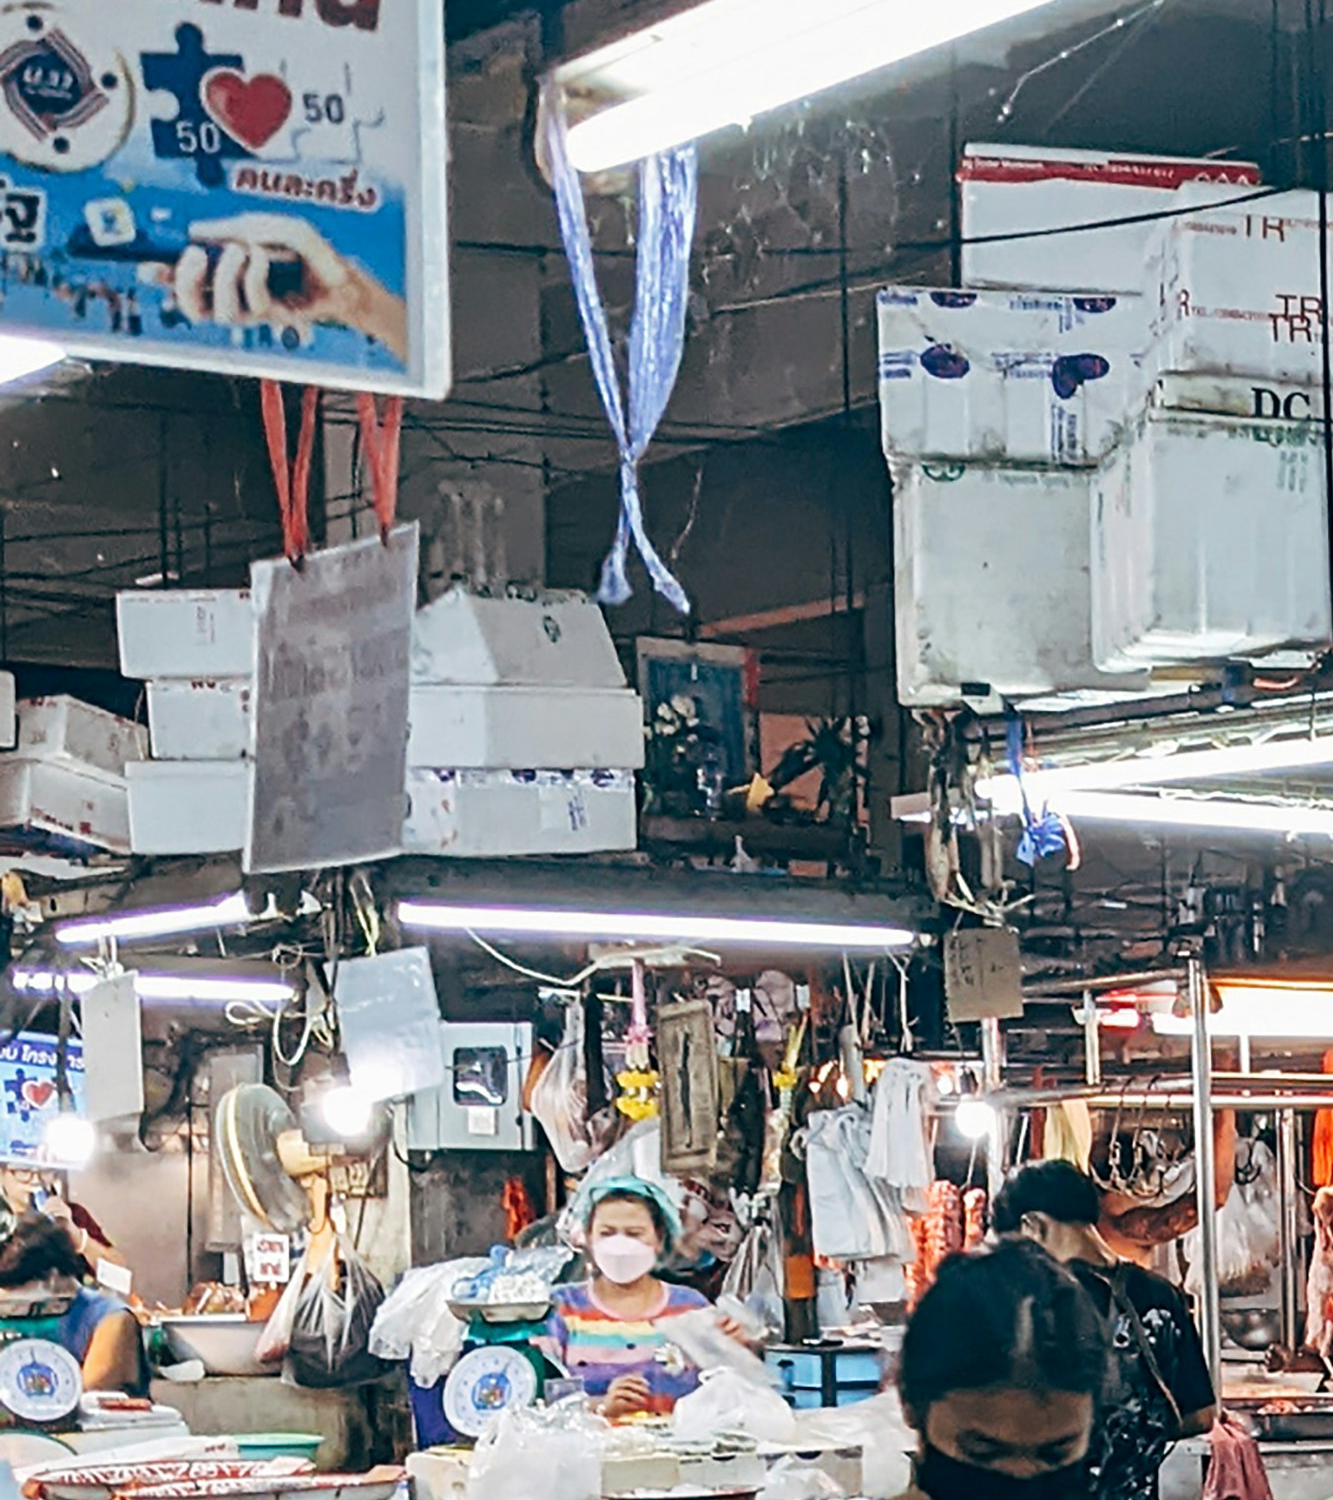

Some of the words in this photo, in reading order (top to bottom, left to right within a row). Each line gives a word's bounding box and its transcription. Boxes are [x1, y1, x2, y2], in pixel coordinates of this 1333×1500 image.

[303, 93, 346, 125] 50
[177, 121, 220, 154] 50
[235, 167, 378, 208] คนละครึ่ง
